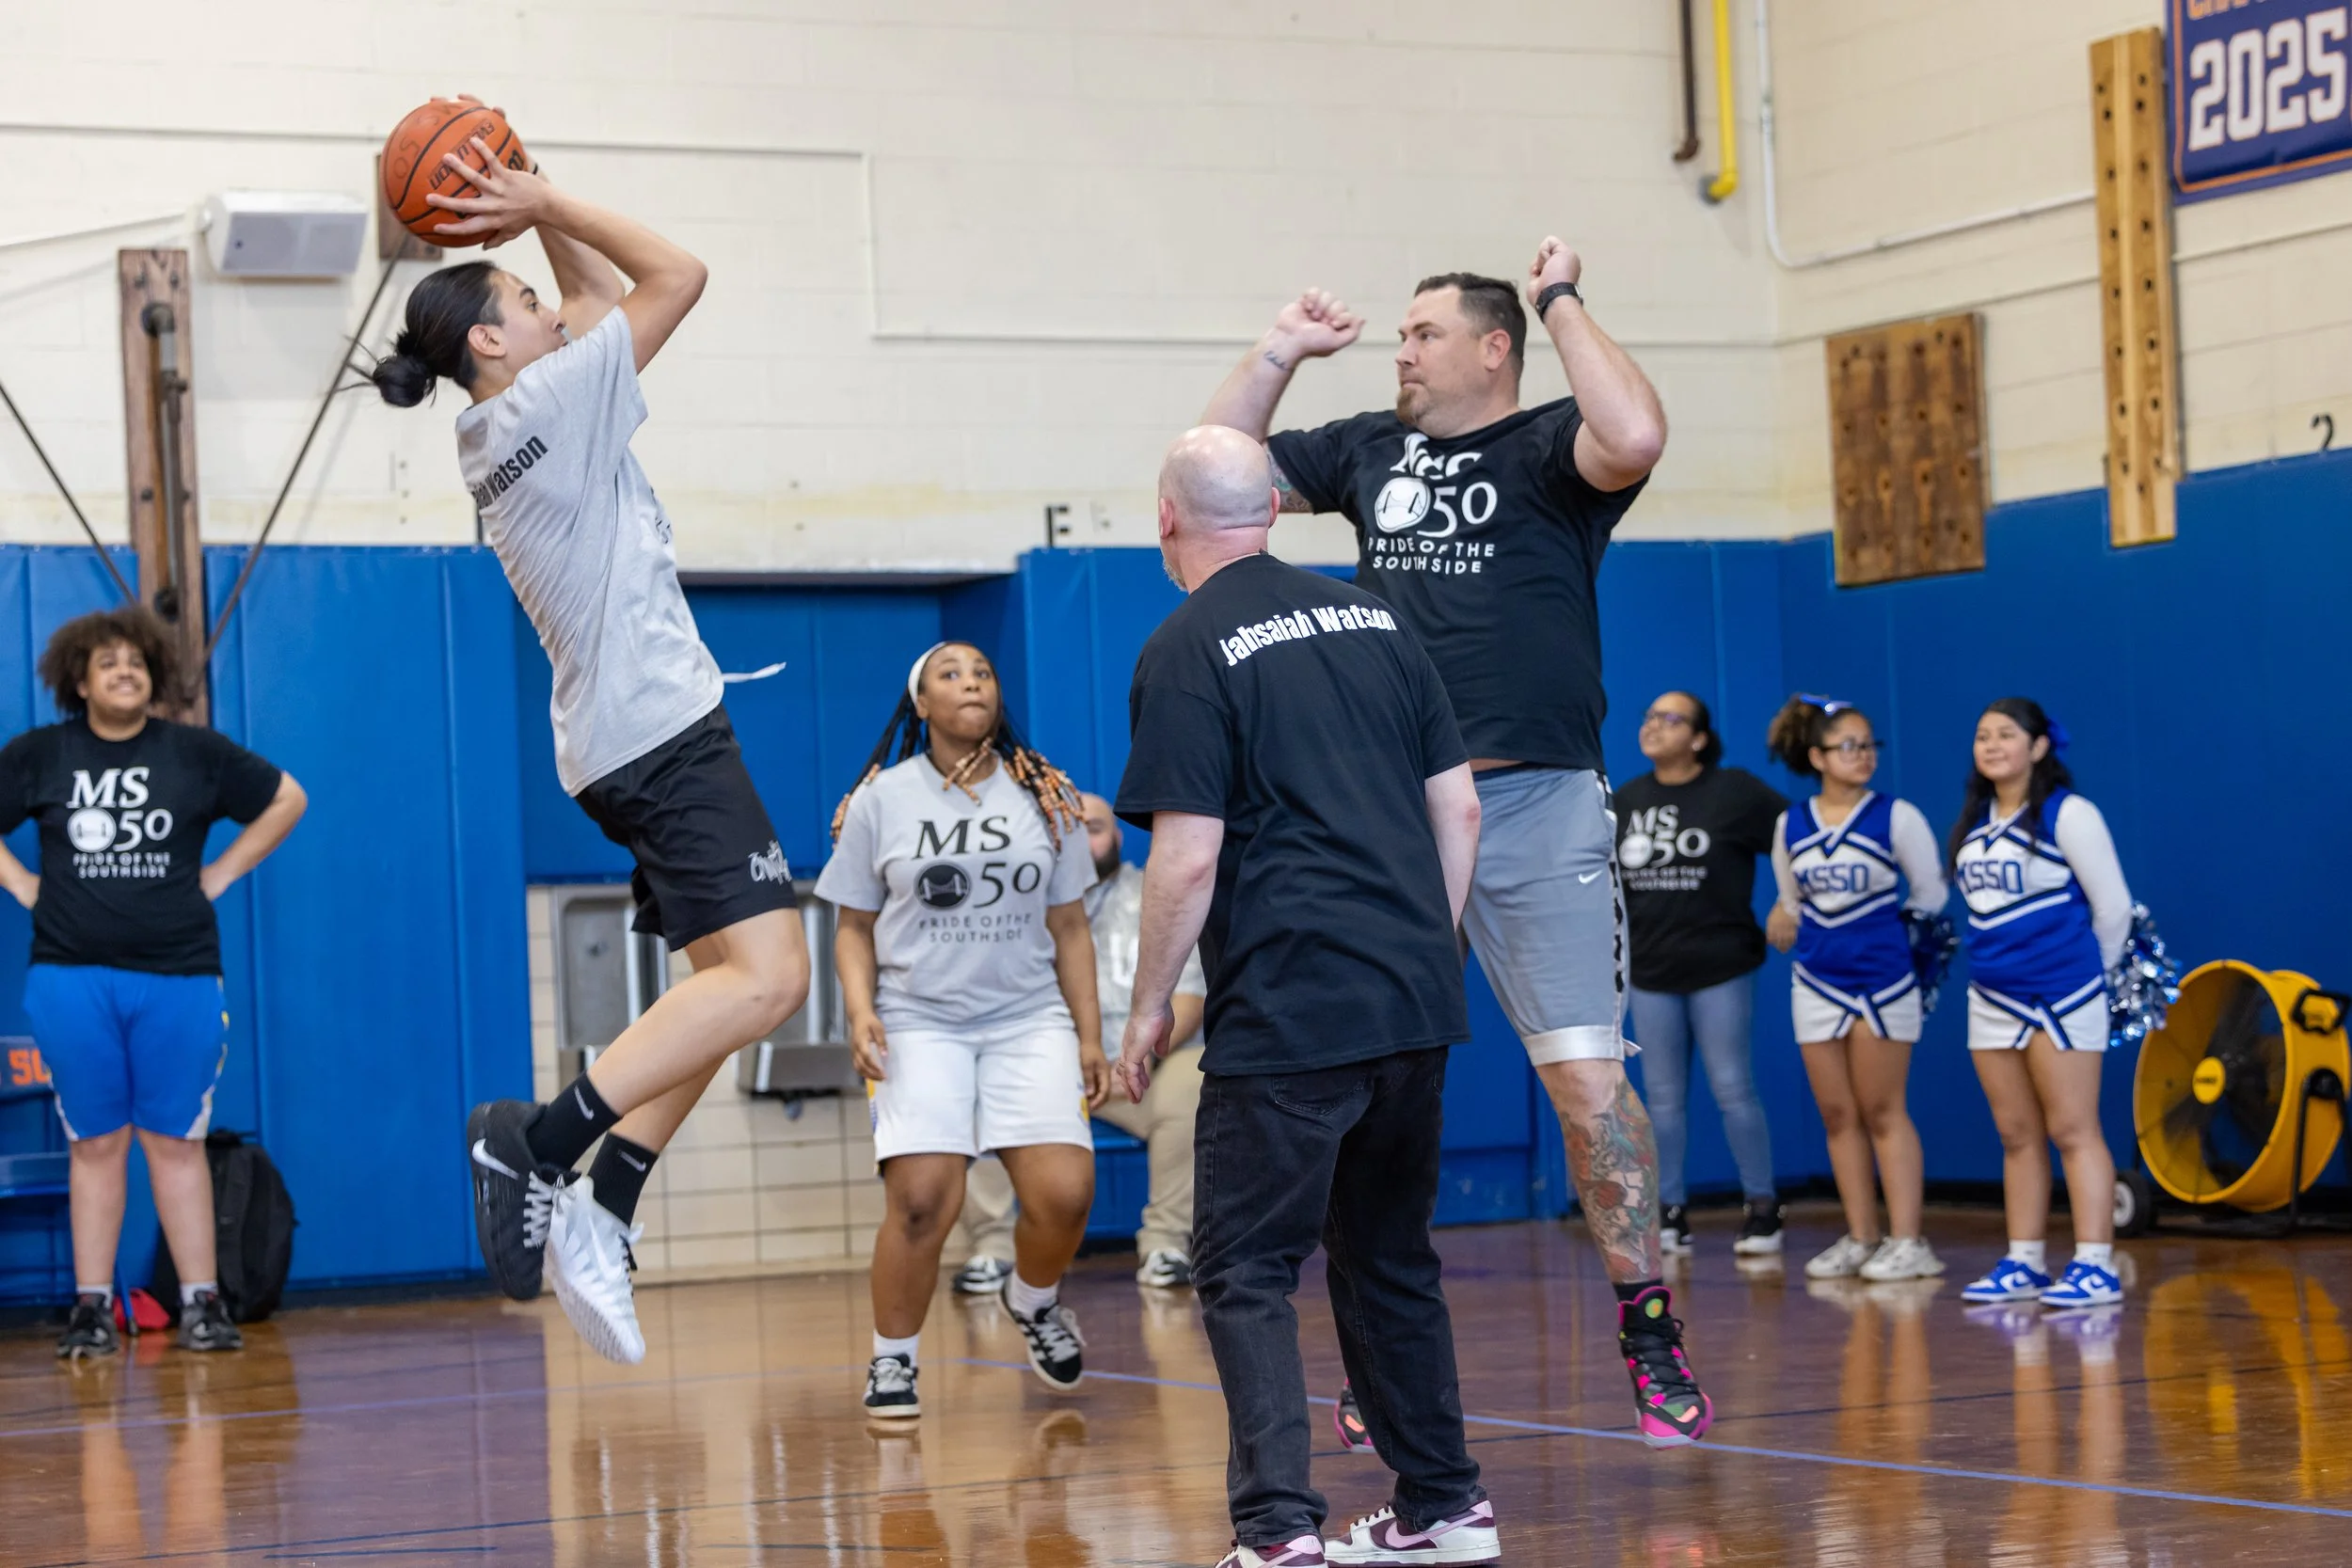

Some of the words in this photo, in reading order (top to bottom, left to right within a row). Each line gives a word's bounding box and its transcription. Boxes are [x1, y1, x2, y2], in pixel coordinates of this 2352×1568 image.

[2188, 7, 2347, 152] 2025
[1417, 482, 1498, 538] 50
[1368, 537, 1415, 553] PRIDE
[1420, 540, 1449, 555] OF
[1455, 542, 1495, 557] THE
[1373, 555, 1482, 575] SOUTHSIDE
[1219, 610, 1317, 667] Jahsaiah
[1311, 605, 1397, 633] Watson
[66, 767, 150, 809] MS
[113, 808, 174, 852] 50
[910, 816, 1011, 861] MS
[1625, 804, 1679, 835] MS
[1649, 827, 1710, 868] 50
[972, 862, 1041, 909] 50
